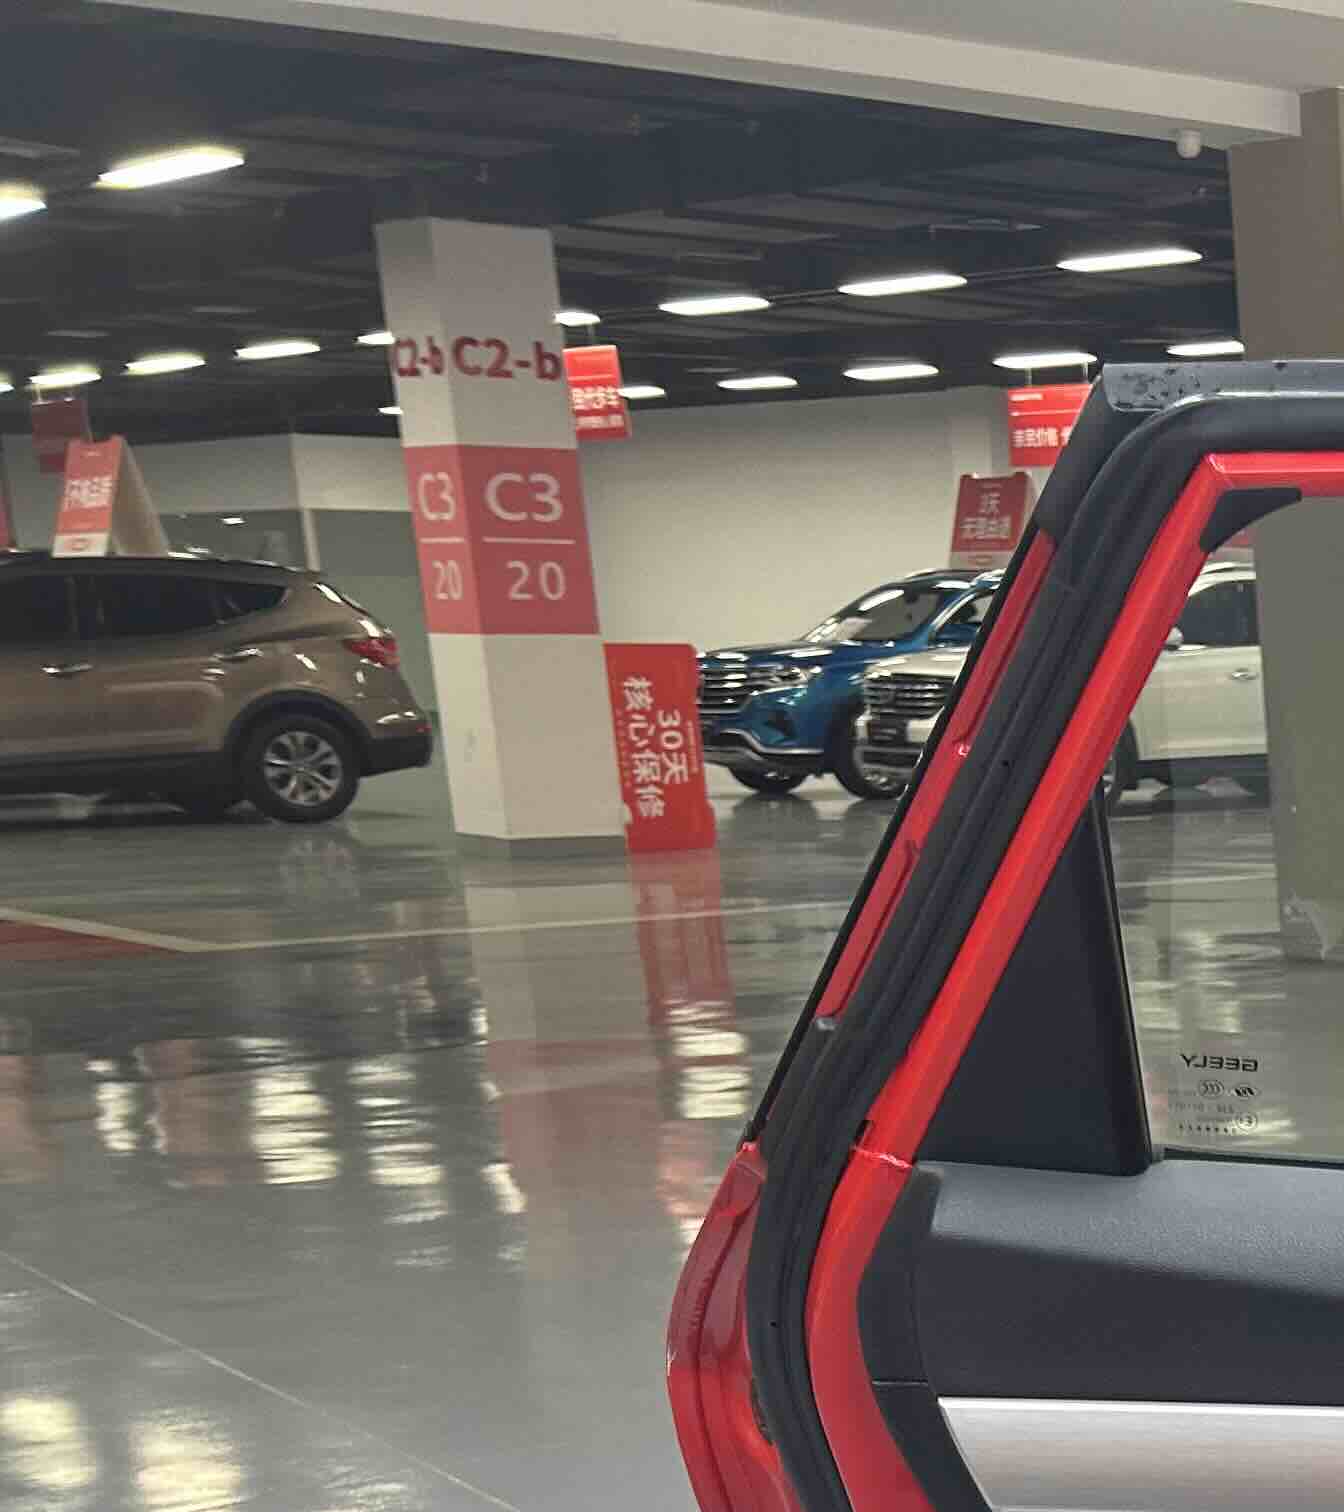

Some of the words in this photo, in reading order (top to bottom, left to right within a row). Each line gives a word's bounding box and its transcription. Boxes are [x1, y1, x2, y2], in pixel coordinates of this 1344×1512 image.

[453, 336, 562, 380] C2-b
[418, 472, 456, 521] C3
[485, 472, 563, 522] C3
[432, 560, 464, 600] 20
[506, 560, 566, 600] 20
[623, 676, 665, 817] 核心保修
[657, 709, 689, 784] 30天
